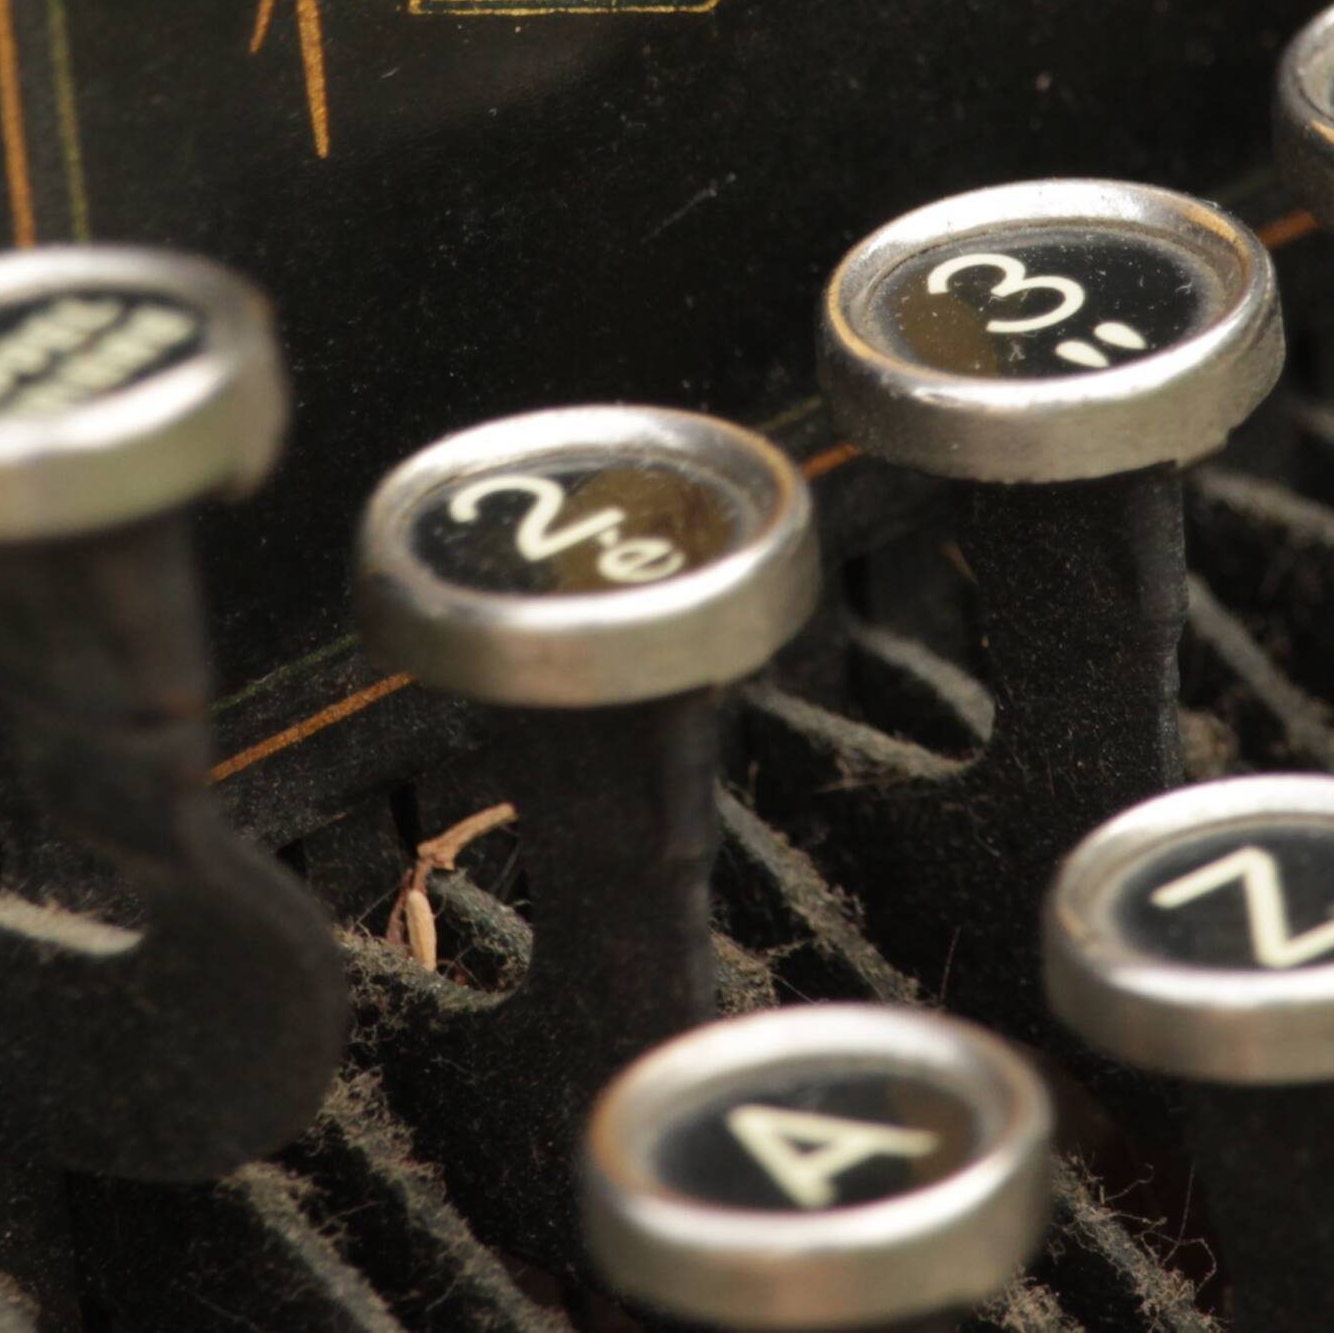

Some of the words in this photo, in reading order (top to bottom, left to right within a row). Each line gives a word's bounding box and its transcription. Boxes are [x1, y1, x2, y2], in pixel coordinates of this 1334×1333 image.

[925, 252, 1087, 337] 3
[449, 474, 626, 563] 2
[724, 1101, 941, 1211] A
